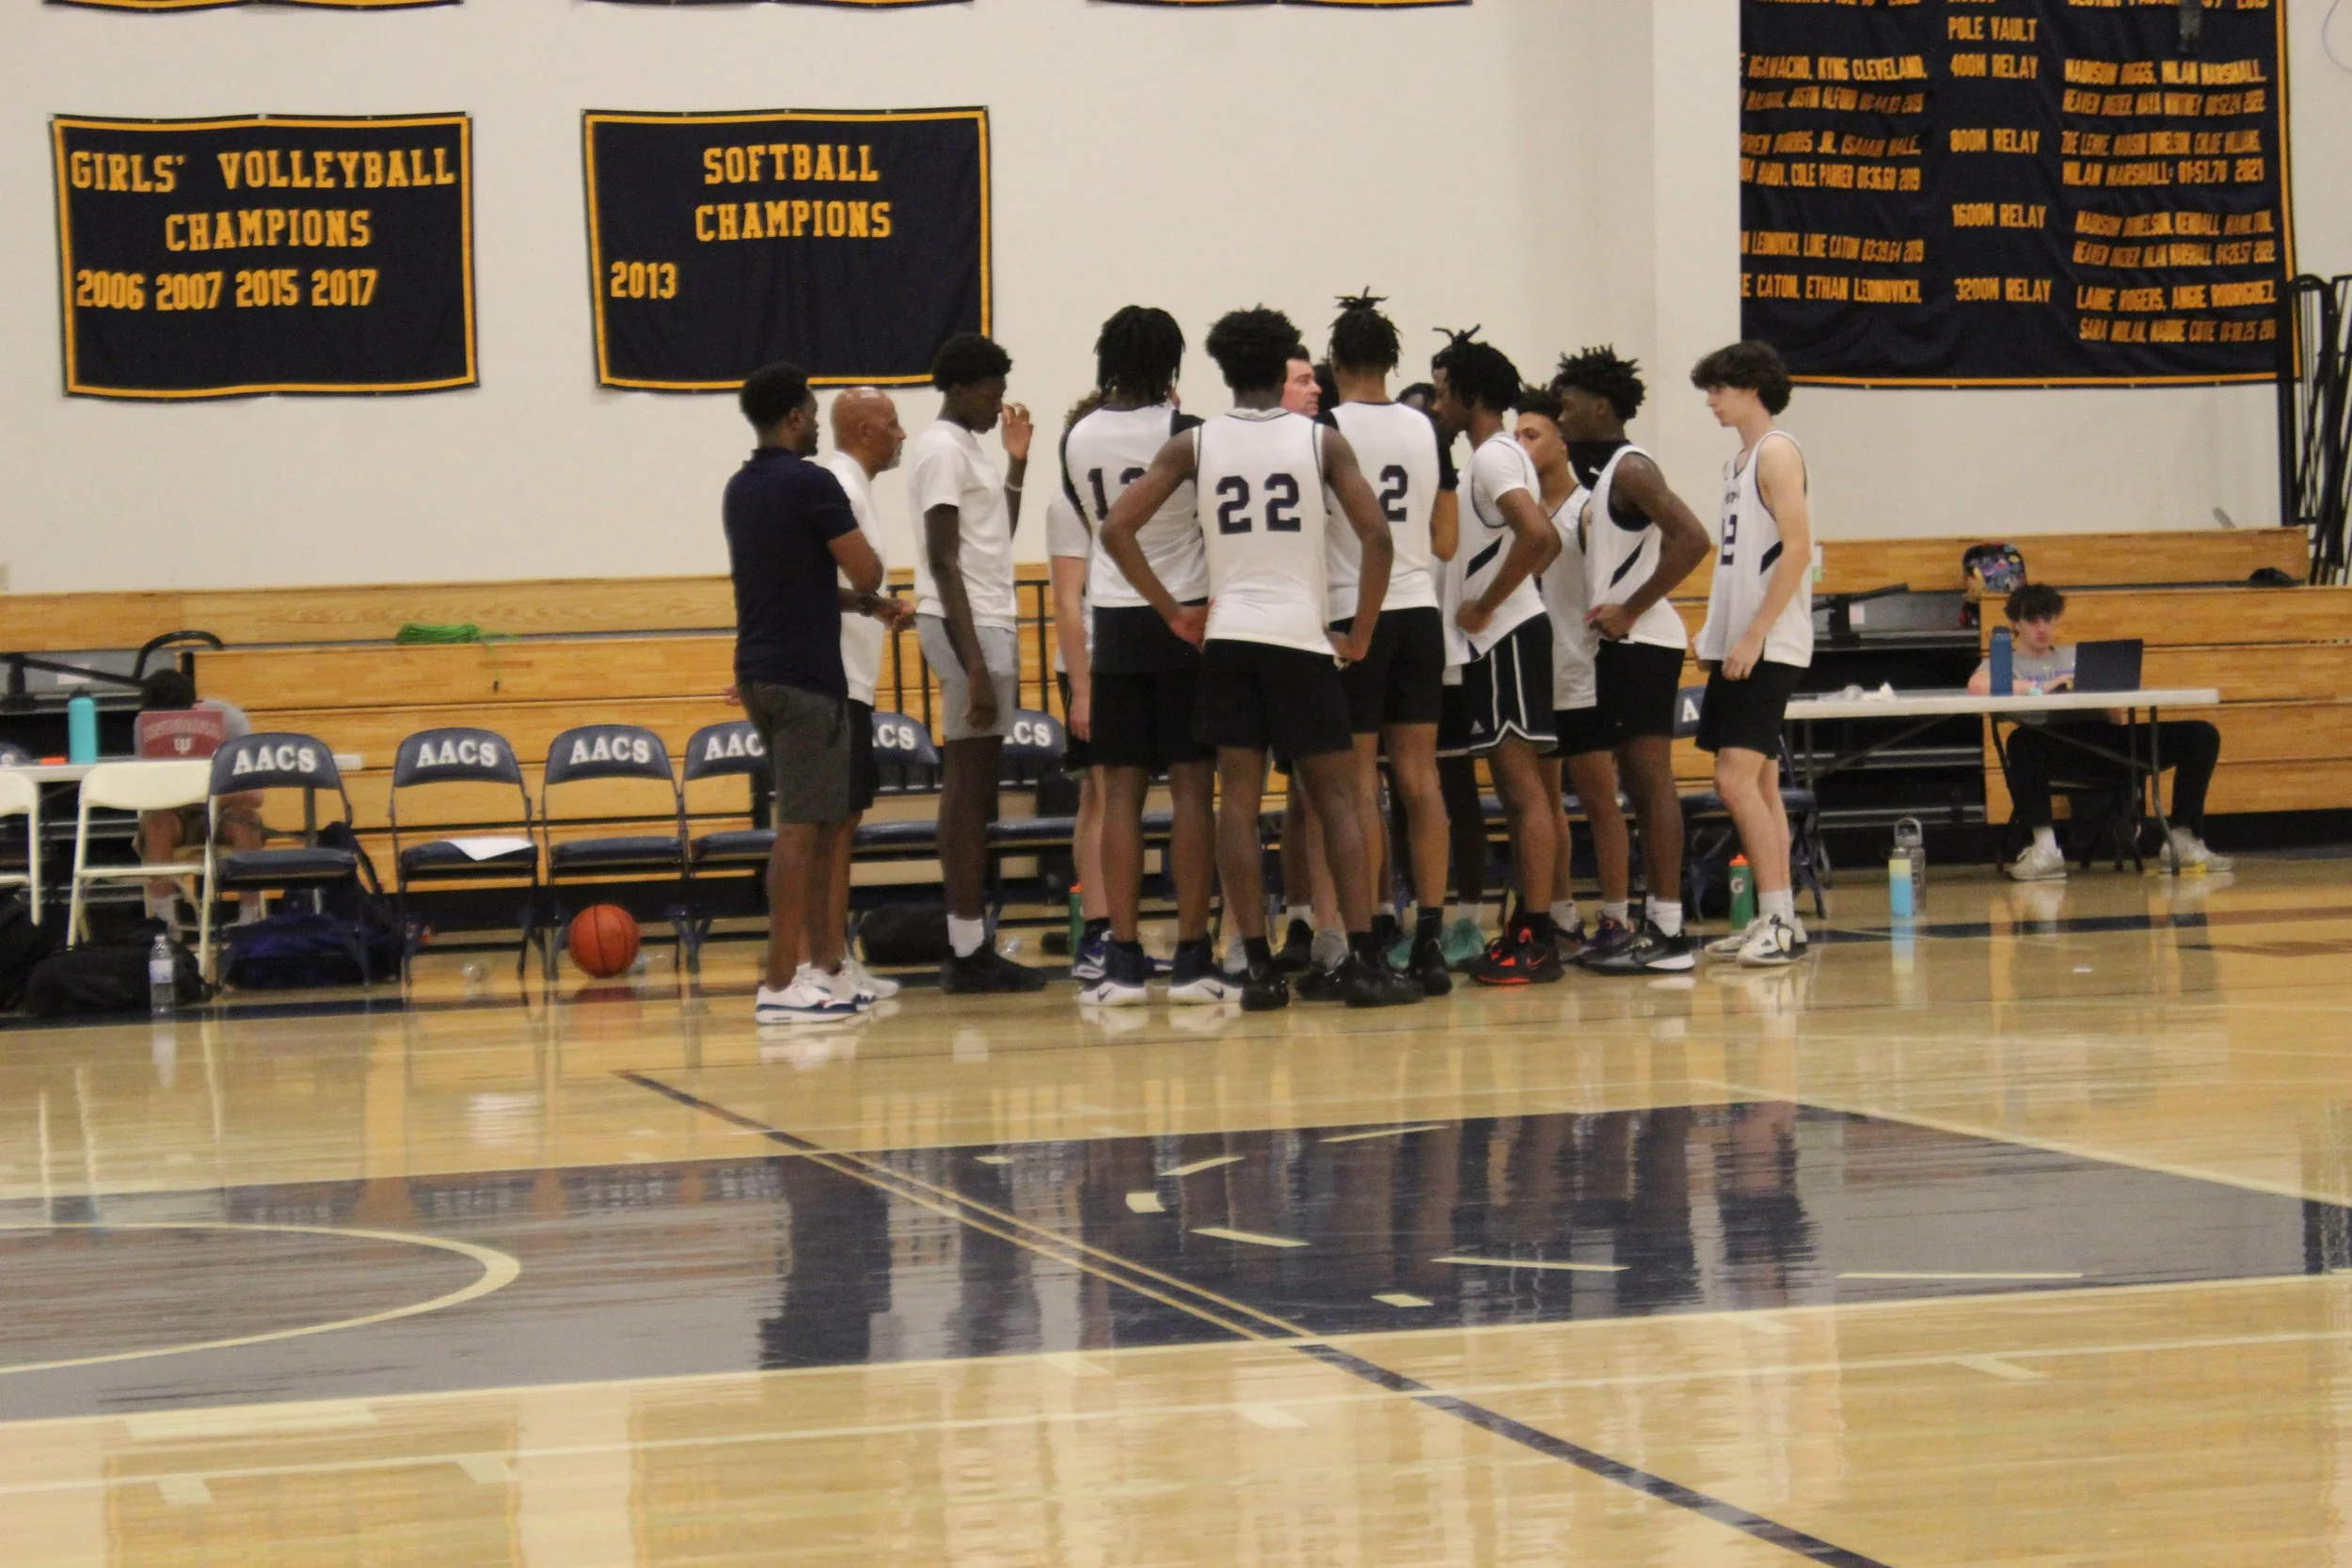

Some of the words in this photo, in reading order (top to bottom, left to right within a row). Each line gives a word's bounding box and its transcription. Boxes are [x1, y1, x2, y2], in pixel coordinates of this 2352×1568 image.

[1947, 15, 1985, 40] POLE
[1990, 15, 2038, 42] VAULT
[1992, 53, 2039, 80] RELAY
[1993, 128, 2041, 154] RELAY
[69, 150, 185, 193] GIRLS'
[217, 147, 456, 190] VOLLEYBALL
[702, 143, 880, 185] SOFTBALL
[165, 208, 373, 251] CHAMPIONS
[694, 200, 893, 242] CHAMPIONS
[1999, 202, 2047, 230] RELAY
[75, 269, 145, 309] 2006
[155, 271, 223, 311] 2007
[235, 269, 299, 308] 2015
[311, 269, 379, 307] 2017
[610, 261, 678, 299] 2013
[1805, 275, 1850, 302] ETHAN
[2005, 277, 2051, 303] RELAY
[1216, 472, 1302, 535] 22
[231, 745, 318, 776] AACS
[416, 739, 499, 769] AACS
[568, 736, 652, 765] AACS
[704, 732, 766, 762] AAC
